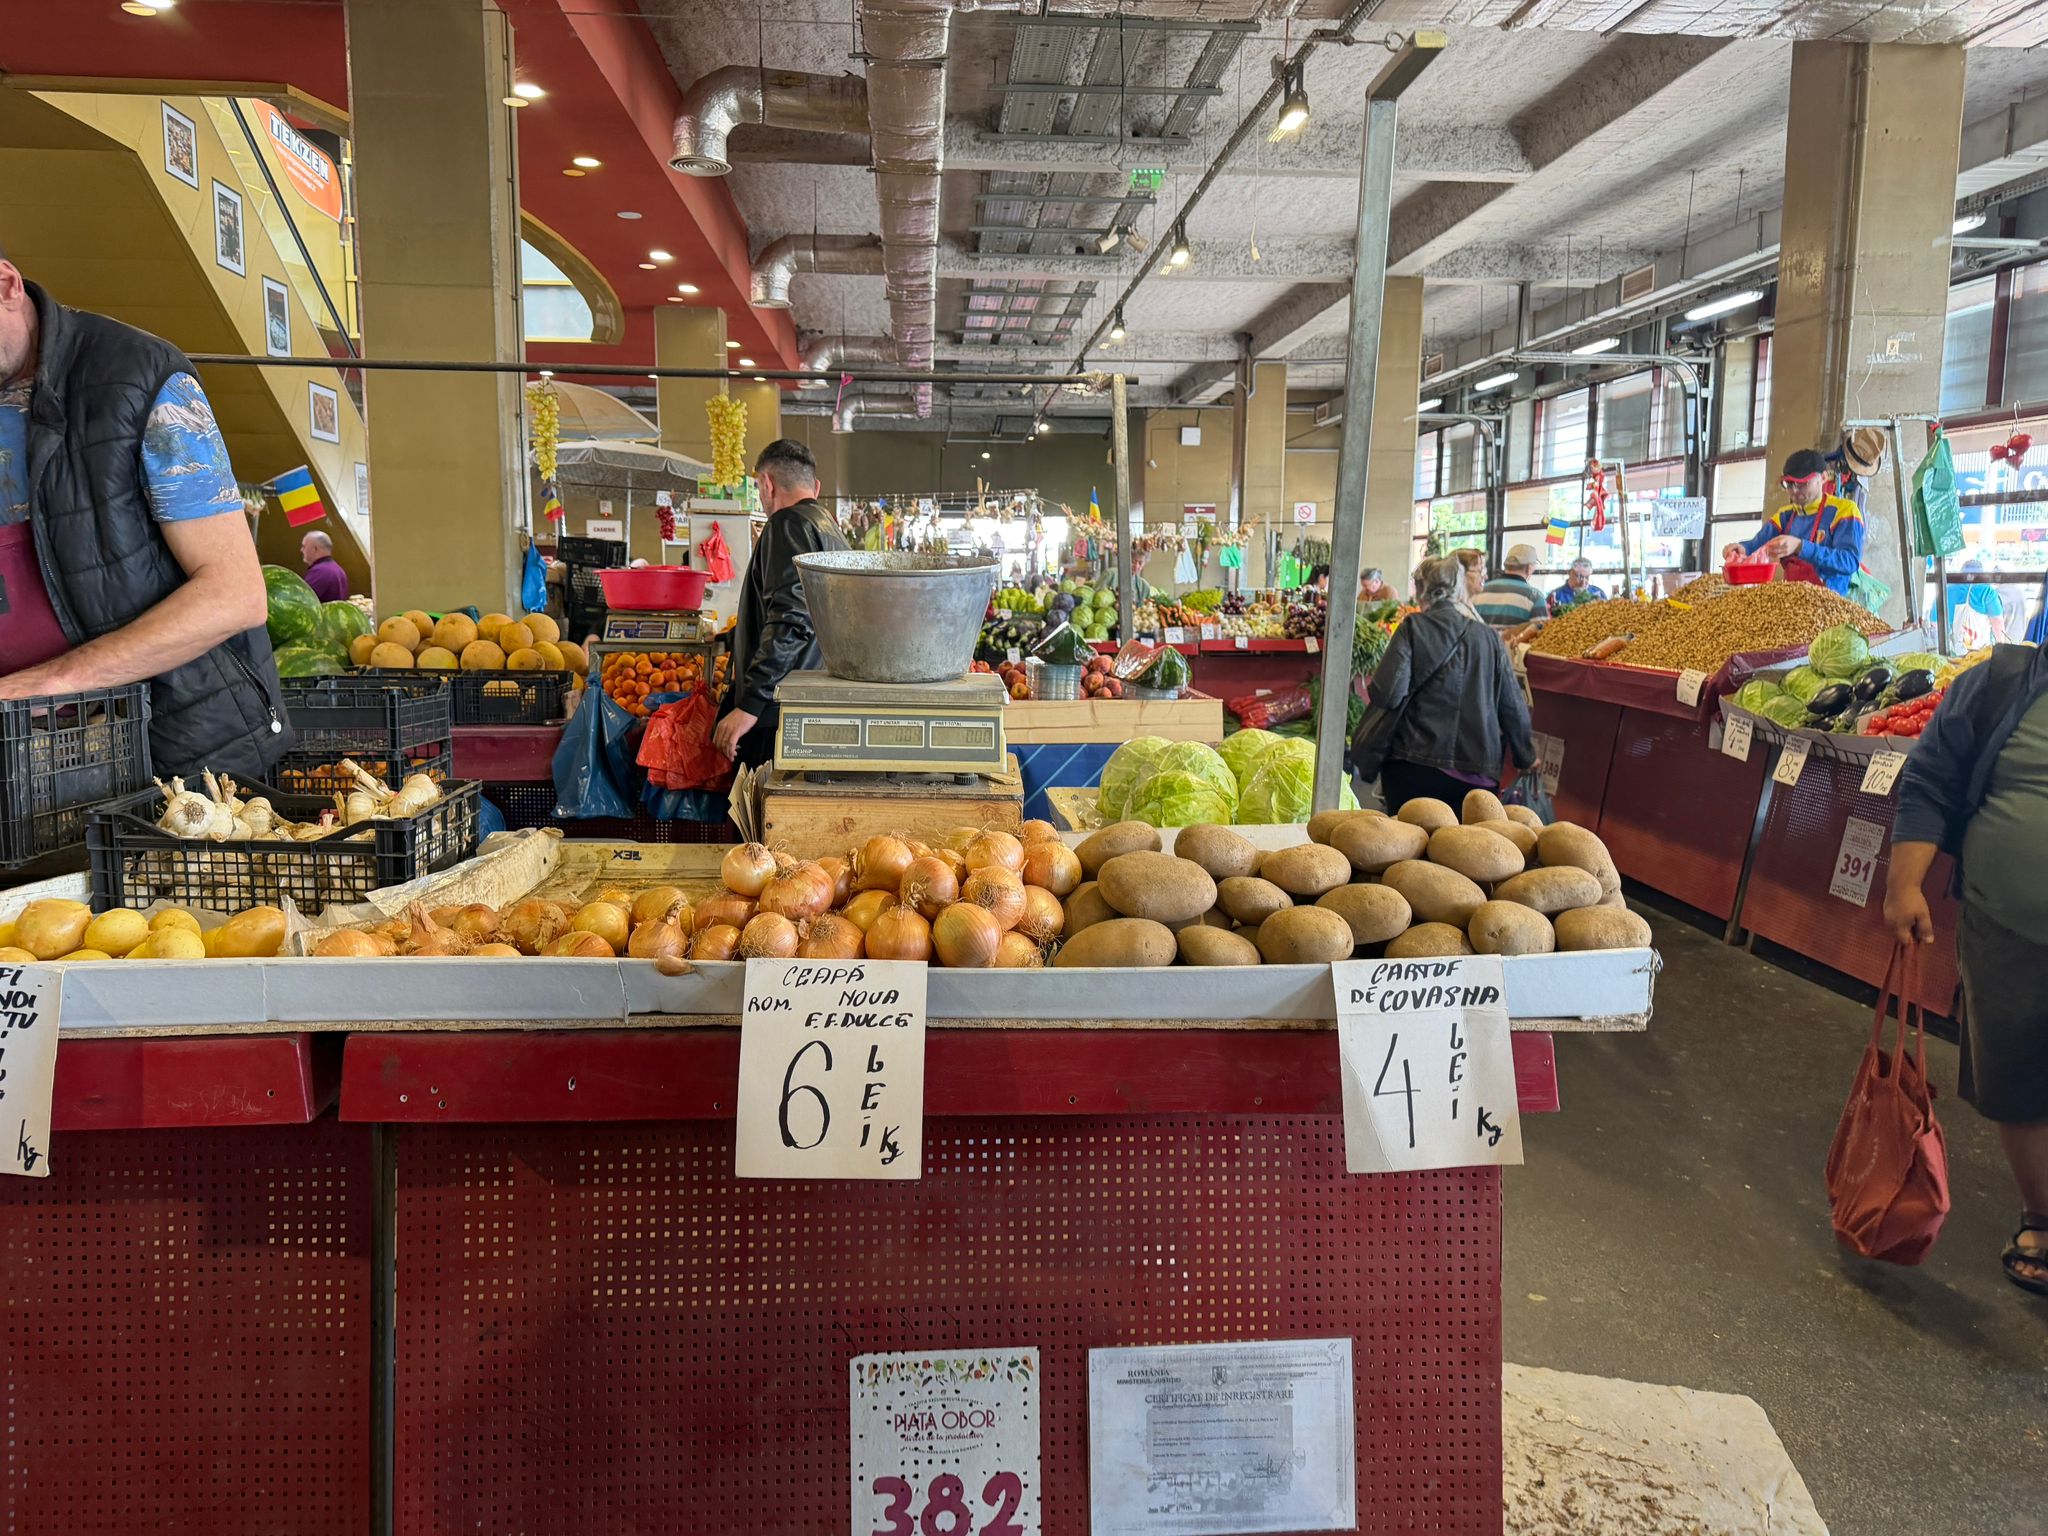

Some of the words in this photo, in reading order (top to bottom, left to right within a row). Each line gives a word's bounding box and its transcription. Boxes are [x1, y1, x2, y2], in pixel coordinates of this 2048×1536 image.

[270, 111, 329, 183] TEKZEN
[1778, 753, 1794, 778] 8
[1865, 769, 1886, 790] 10
[1840, 853, 1872, 882] 391
[1371, 960, 1463, 985] CARTOF
[838, 989, 899, 1007] NOUA
[1379, 985, 1500, 1013] COVASNA
[778, 1040, 832, 1149] 6
[1373, 1033, 1421, 1148] 4
[1145, 1392, 1203, 1405] CERTIFICAT
[1204, 1392, 1220, 1403] DE
[941, 1409, 996, 1430] OBOR
[936, 1433, 944, 1441] la
[872, 1471, 1023, 1536] 382
